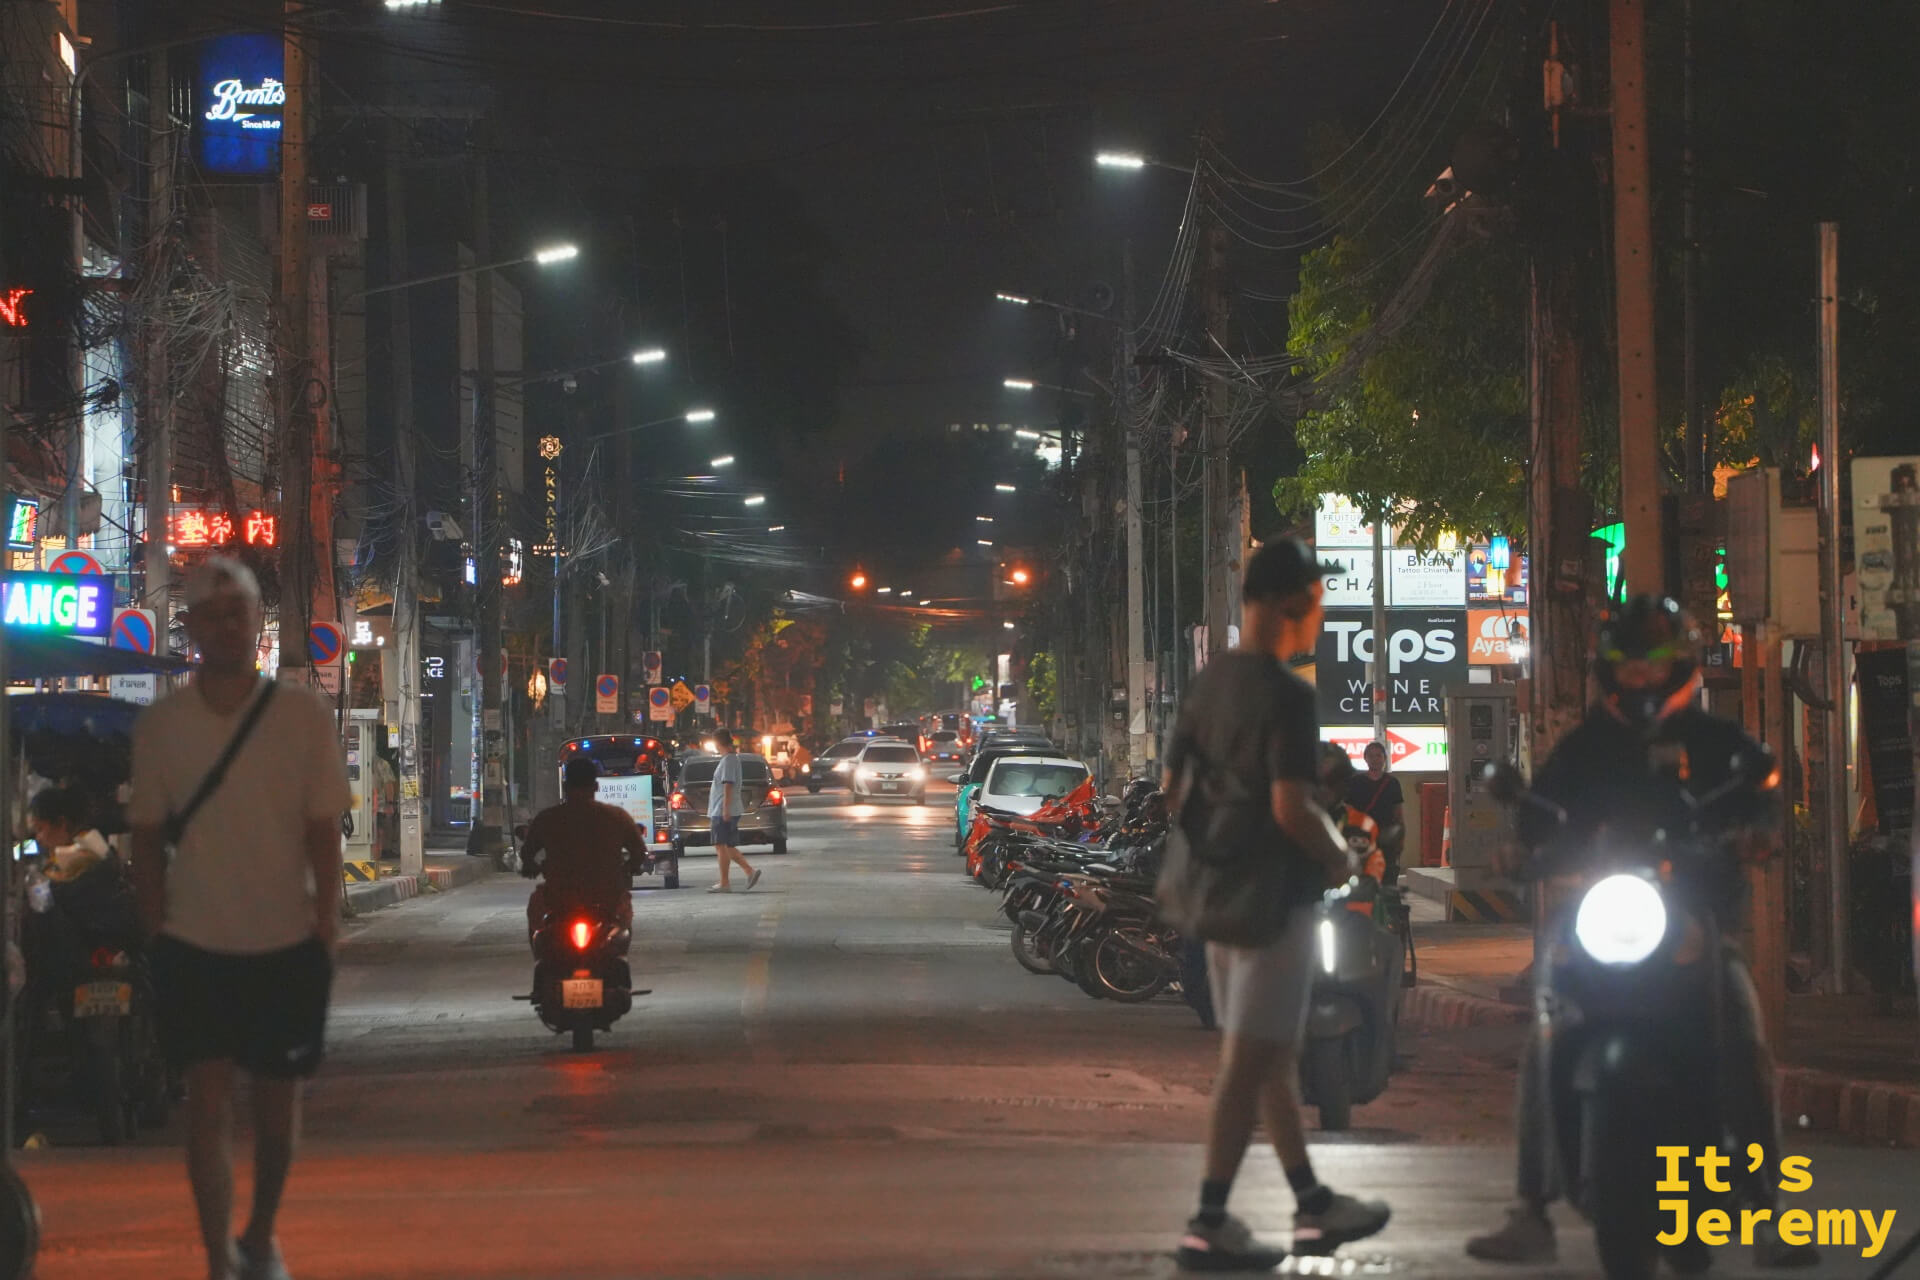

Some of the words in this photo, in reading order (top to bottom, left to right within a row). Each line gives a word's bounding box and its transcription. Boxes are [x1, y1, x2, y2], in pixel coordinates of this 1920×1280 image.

[1324, 621, 1456, 674] Tops
[1347, 679, 1430, 694] WNE
[1339, 698, 1441, 713] CELAR
